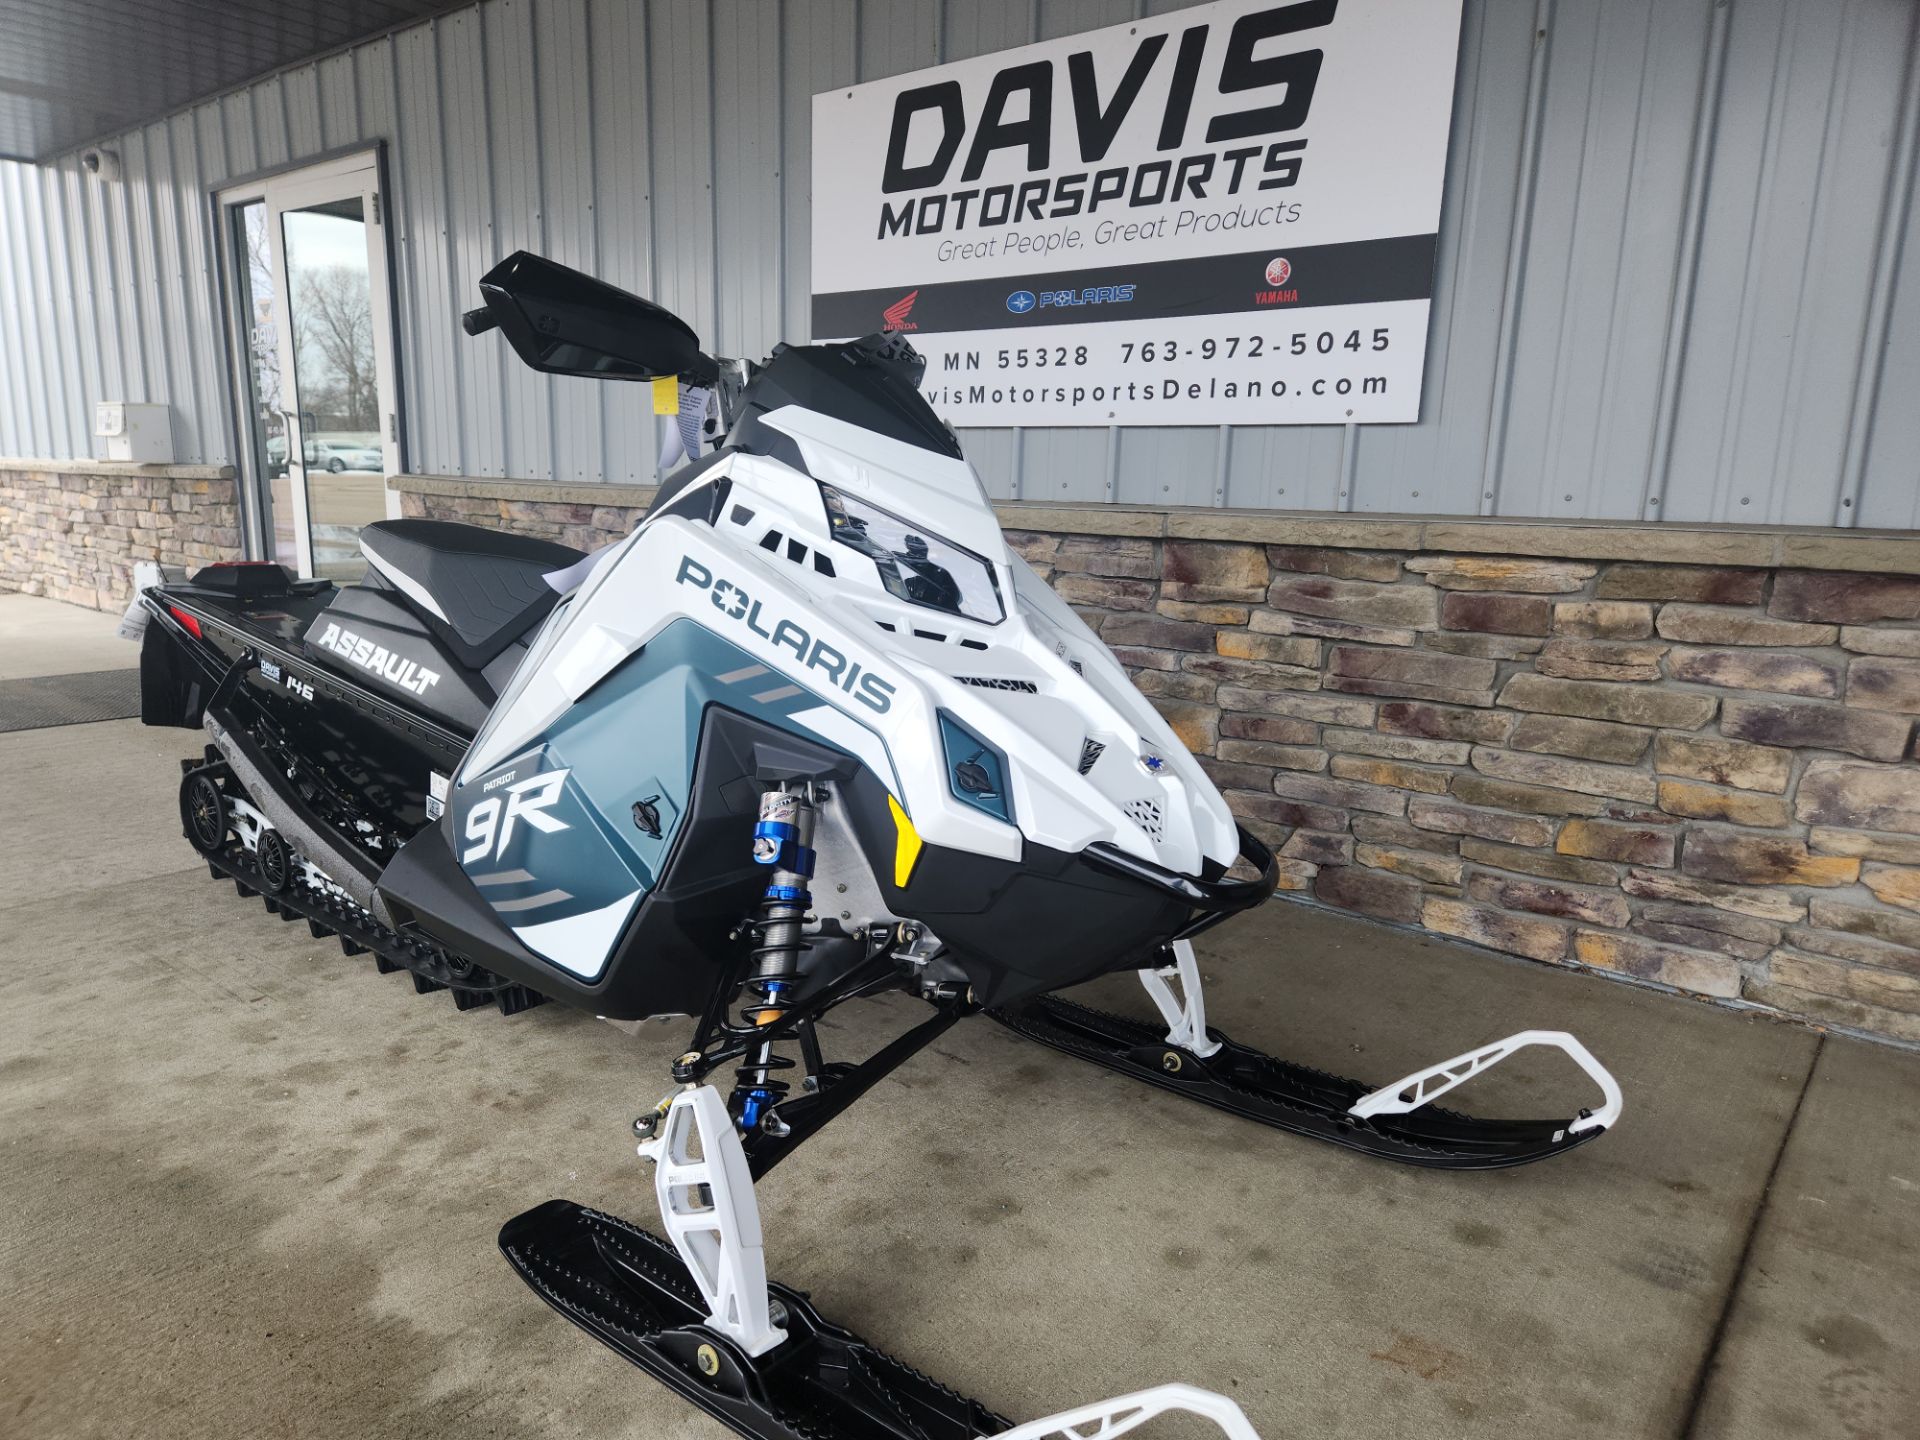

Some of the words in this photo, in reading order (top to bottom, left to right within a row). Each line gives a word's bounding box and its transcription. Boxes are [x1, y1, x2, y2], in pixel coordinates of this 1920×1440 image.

[882, 0, 1339, 194] DAVIS
[878, 138, 1308, 240] MOTORSPORTS
[937, 238, 997, 262] Great
[1003, 226, 1084, 257] People,
[1094, 214, 1168, 245] Great
[1175, 200, 1303, 236] Products
[1040, 284, 1134, 308] POLARIS
[1255, 289, 1298, 305] YAMAHA
[883, 322, 918, 331] HONDA
[944, 352, 981, 371] MN
[998, 346, 1088, 369] 55328
[1121, 328, 1389, 364] 763-972-5045
[928, 376, 1387, 406] visMotorsportsDelano.com
[675, 555, 897, 714] POLARIS
[318, 622, 440, 697] ASSAULT
[286, 675, 315, 702] 146
[483, 770, 517, 793] PATRIOT
[463, 768, 571, 865] 9R
